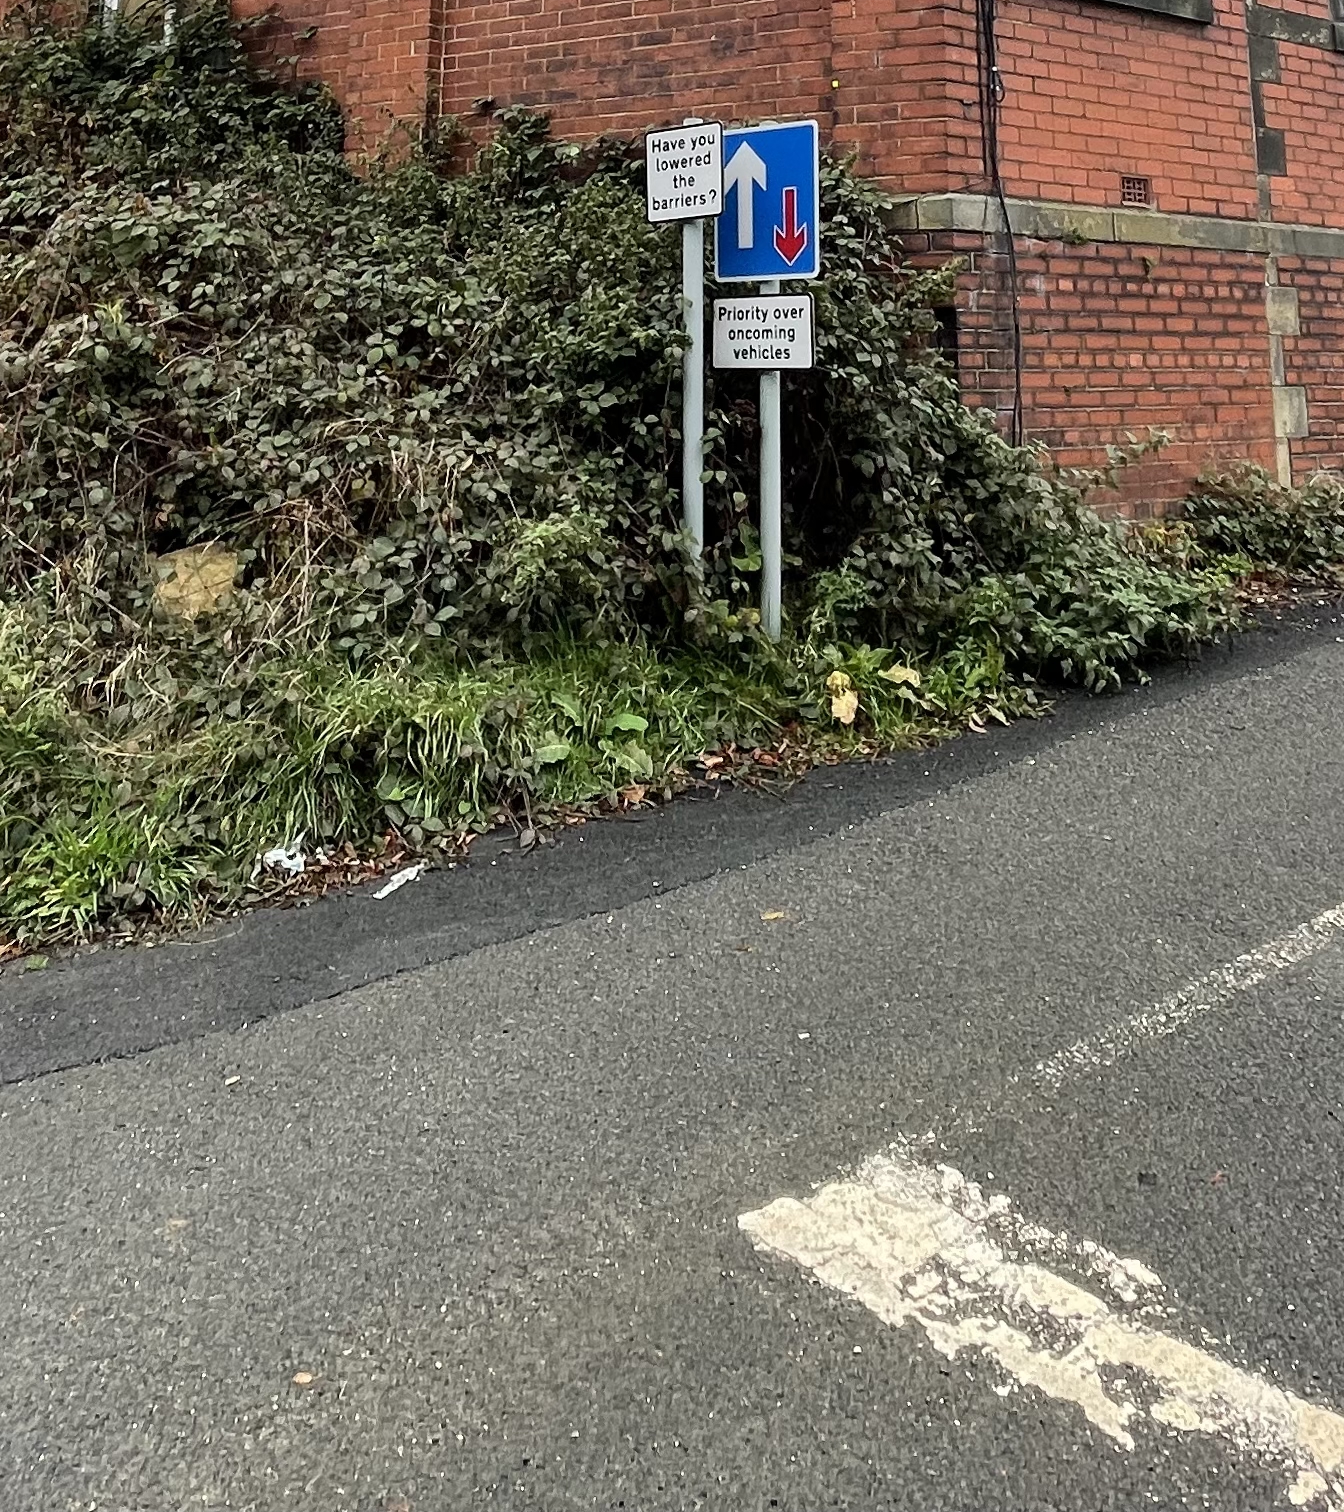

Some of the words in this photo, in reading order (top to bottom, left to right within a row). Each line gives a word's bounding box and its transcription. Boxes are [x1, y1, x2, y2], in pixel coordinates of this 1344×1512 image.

[651, 138, 685, 154] Have
[691, 132, 715, 149] you
[656, 151, 712, 173] lowered
[672, 174, 695, 189] the
[718, 305, 768, 323] Priority
[773, 306, 804, 320] over
[727, 325, 796, 341] oncoming
[733, 345, 791, 360] vehicles
